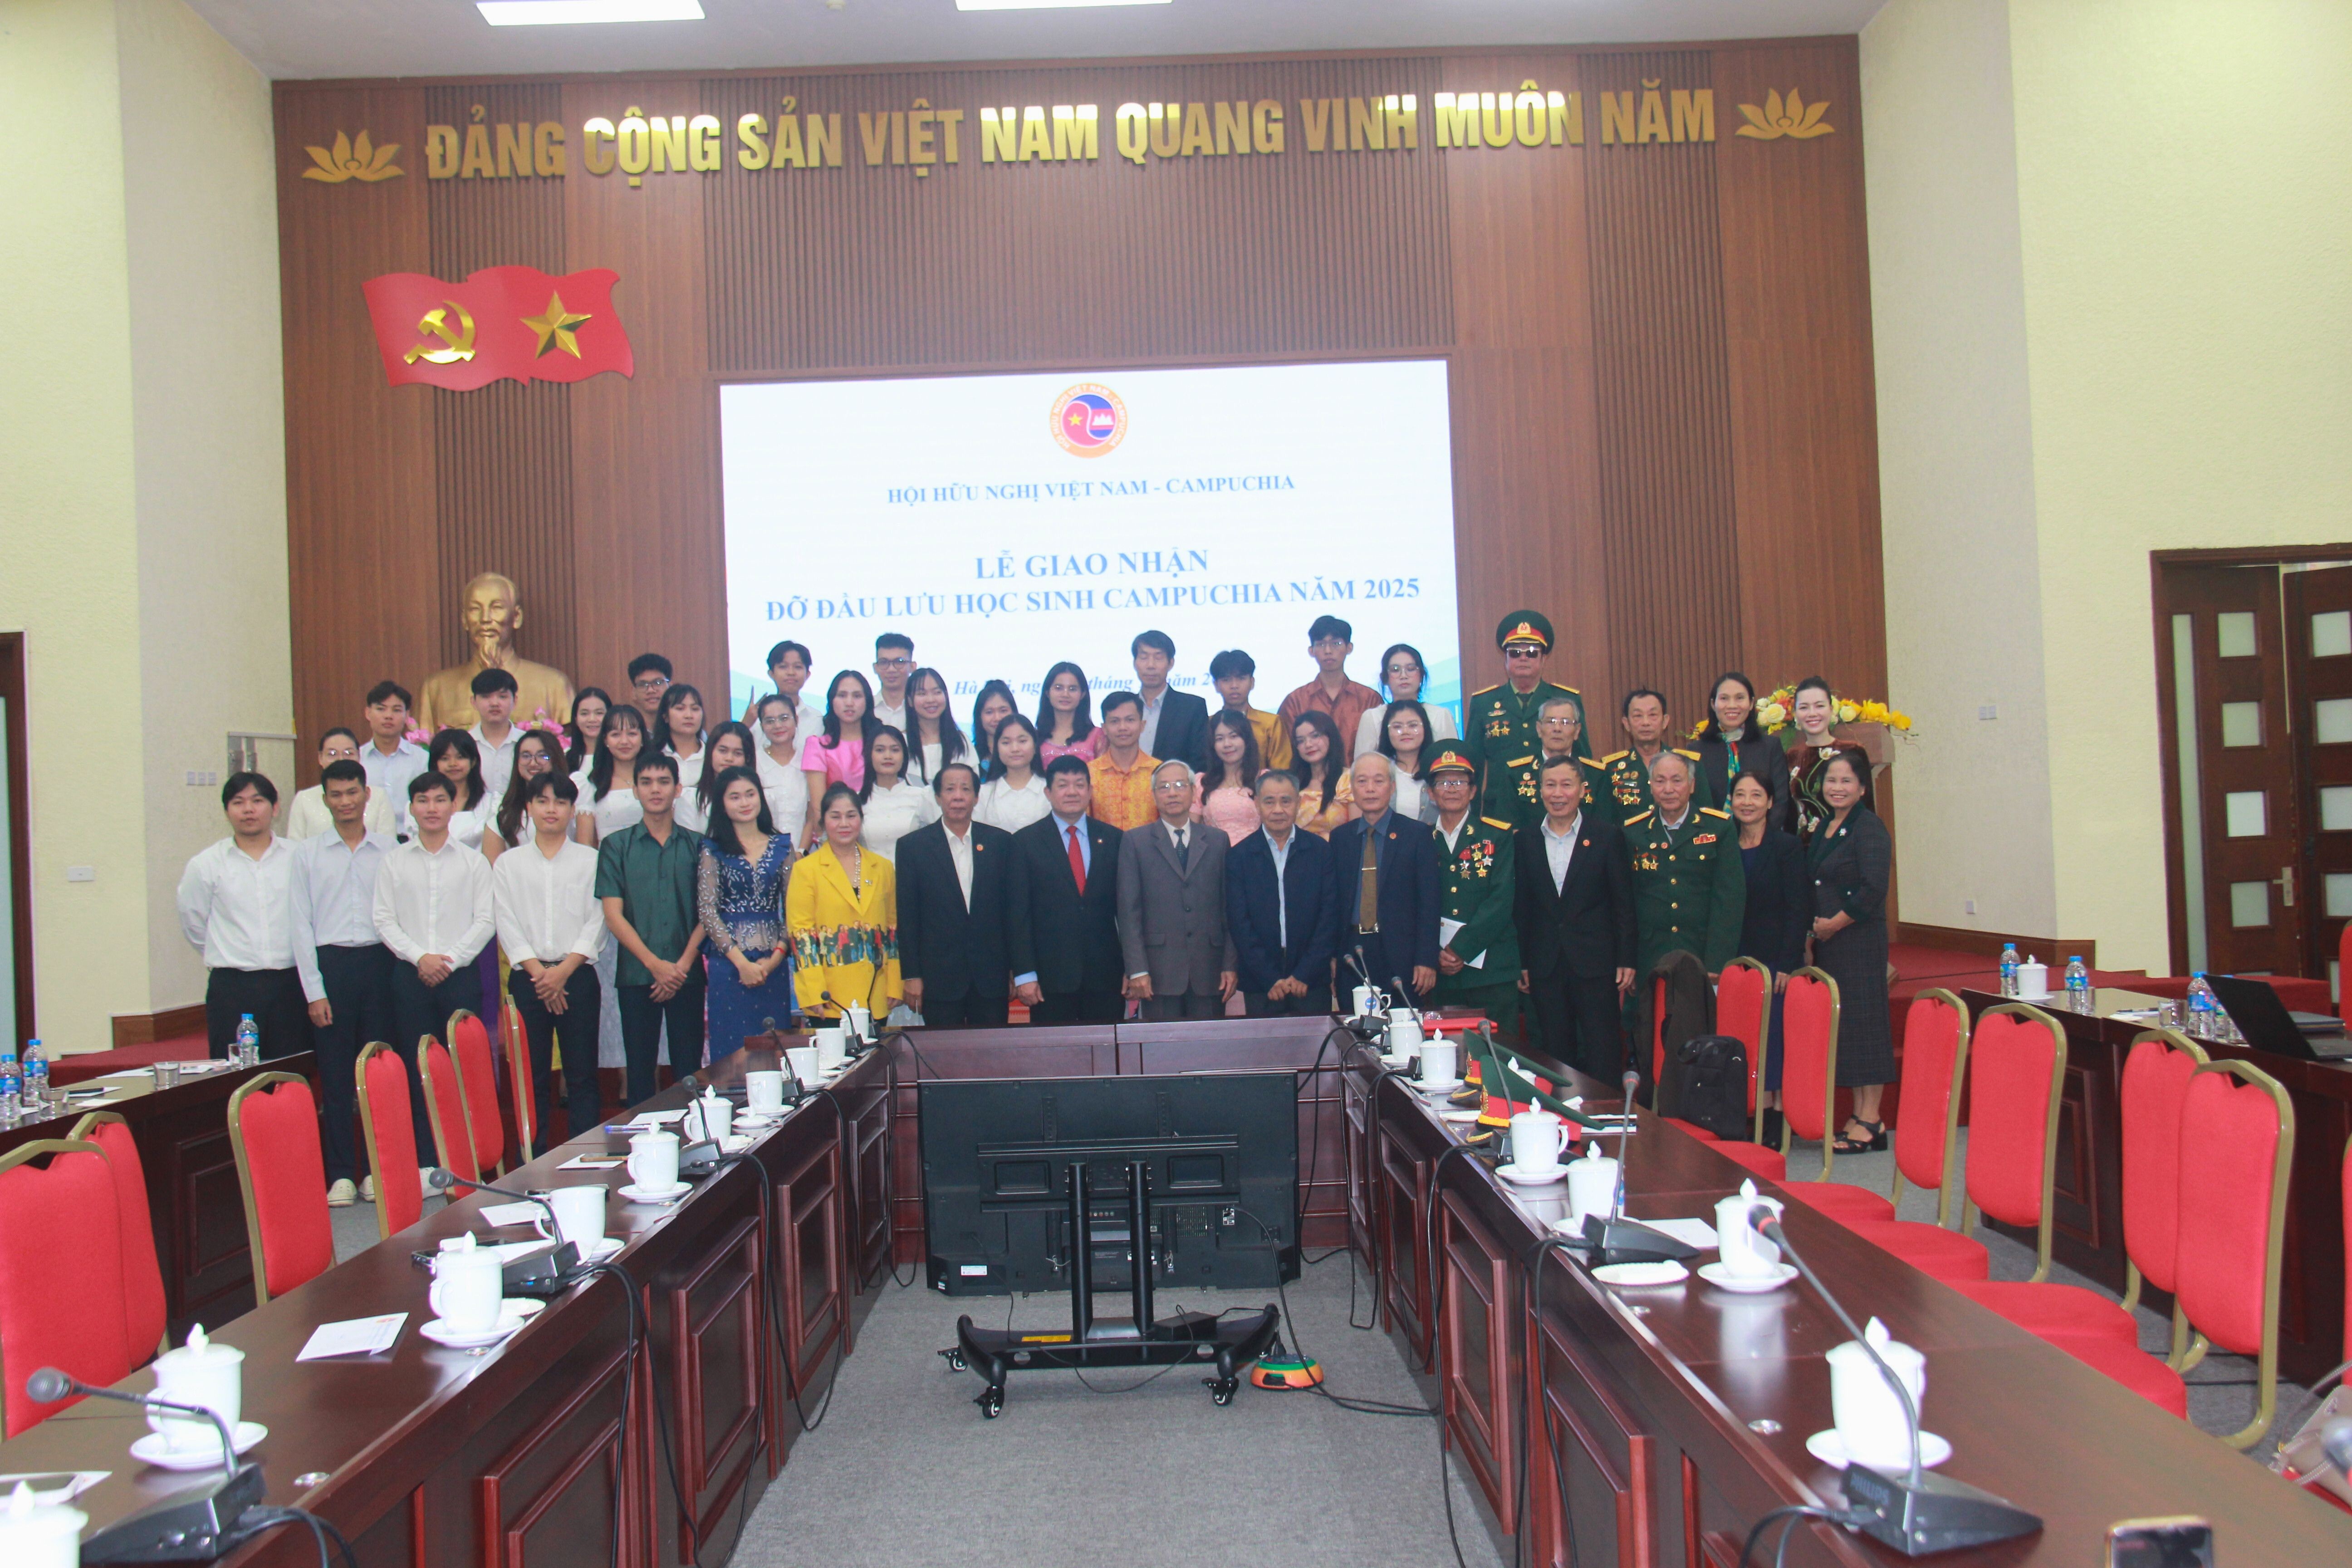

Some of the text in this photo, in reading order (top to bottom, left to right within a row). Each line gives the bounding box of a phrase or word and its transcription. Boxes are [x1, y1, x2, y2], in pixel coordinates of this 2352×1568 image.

[425, 78, 1715, 186] ĐẢNG CỘNG SẢN VIỆT NAM QUANG VINH MUÔN NĂM
[887, 486, 926, 507] HỘI
[933, 482, 979, 502] HỮU
[985, 484, 1039, 502] NGHỊ
[1044, 480, 1094, 501] VIỆT
[1100, 480, 1148, 496] NAM
[1166, 475, 1295, 494] CAMPUCHIA
[975, 546, 1209, 579] LỄ GIAO NHẬN
[766, 575, 1421, 621] ĐỠ ĐẦU LƯU HỌC SINH CAMPUCHIA NĂM 2025
[954, 681, 977, 695] Hà
[1088, 676, 1133, 692] tháng
